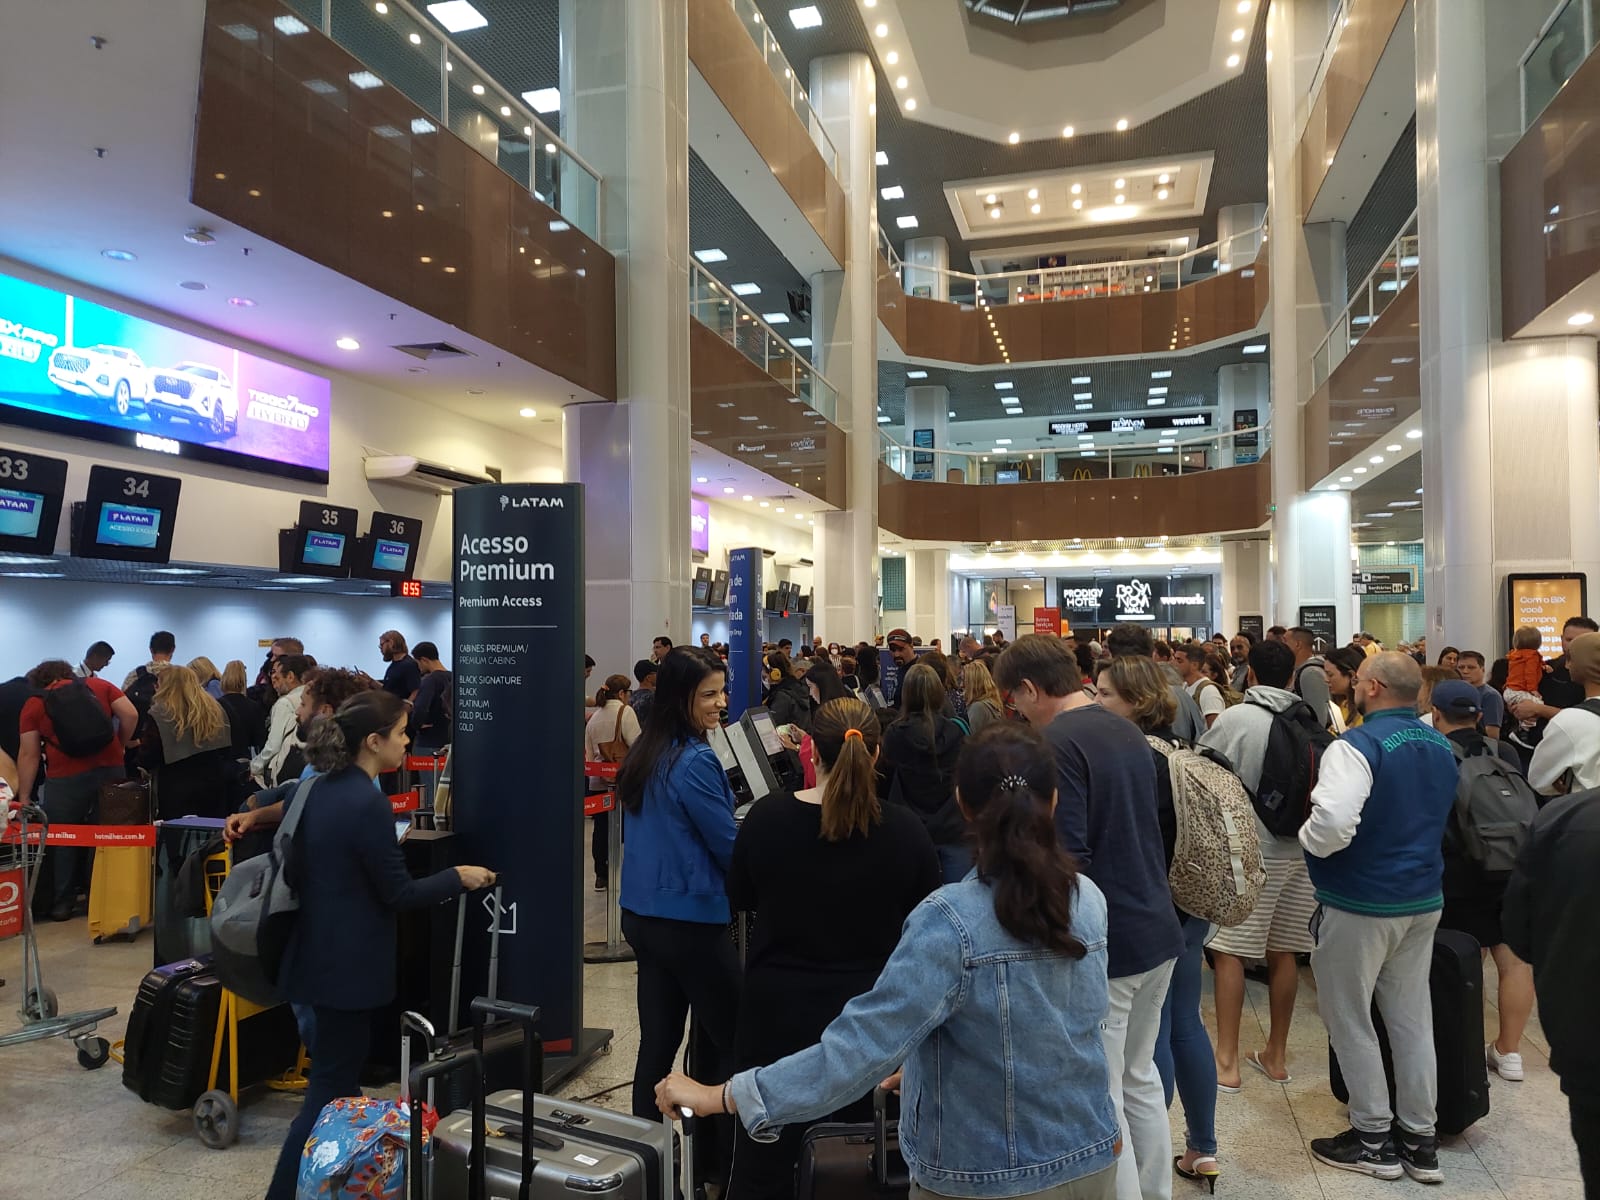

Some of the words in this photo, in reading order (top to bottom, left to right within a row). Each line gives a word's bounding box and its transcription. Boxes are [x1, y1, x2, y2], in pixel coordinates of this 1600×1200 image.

[1172, 414, 1206, 426] wework
[0, 456, 29, 481] 33
[123, 477, 150, 498] 34
[0, 500, 29, 510] ATAM
[512, 498, 564, 508] LATAM
[120, 514, 149, 524] LATAM
[321, 509, 339, 526] 35
[389, 520, 405, 535] 36
[318, 539, 338, 547] LATAM
[460, 533, 529, 556] Acesso
[460, 558, 555, 582] Premium
[734, 574, 743, 587] de
[1064, 588, 1104, 598] PRODIGY
[460, 595, 499, 608] Premium
[502, 594, 543, 607] Access
[1066, 598, 1102, 607] HOTEL
[1116, 596, 1151, 609] NOVA
[1160, 592, 1206, 606] wework
[1520, 596, 1542, 604] Com
[1520, 606, 1543, 614] você
[1520, 616, 1557, 624] compra
[460, 644, 485, 653] CABINES
[486, 644, 529, 654] PREMIUM/
[460, 655, 487, 665] PREMIUM
[488, 656, 516, 665] CABINS
[459, 675, 478, 684] BLACK
[478, 676, 522, 685] SIGNATURE
[459, 687, 478, 696] BLACK
[459, 699, 490, 709] PLATINUM
[459, 711, 474, 720] GOLD
[475, 711, 493, 721] PLUS
[459, 722, 474, 732] GOLD
[56, 832, 77, 840] milhas
[94, 832, 146, 841] hotmilhas.com.br
